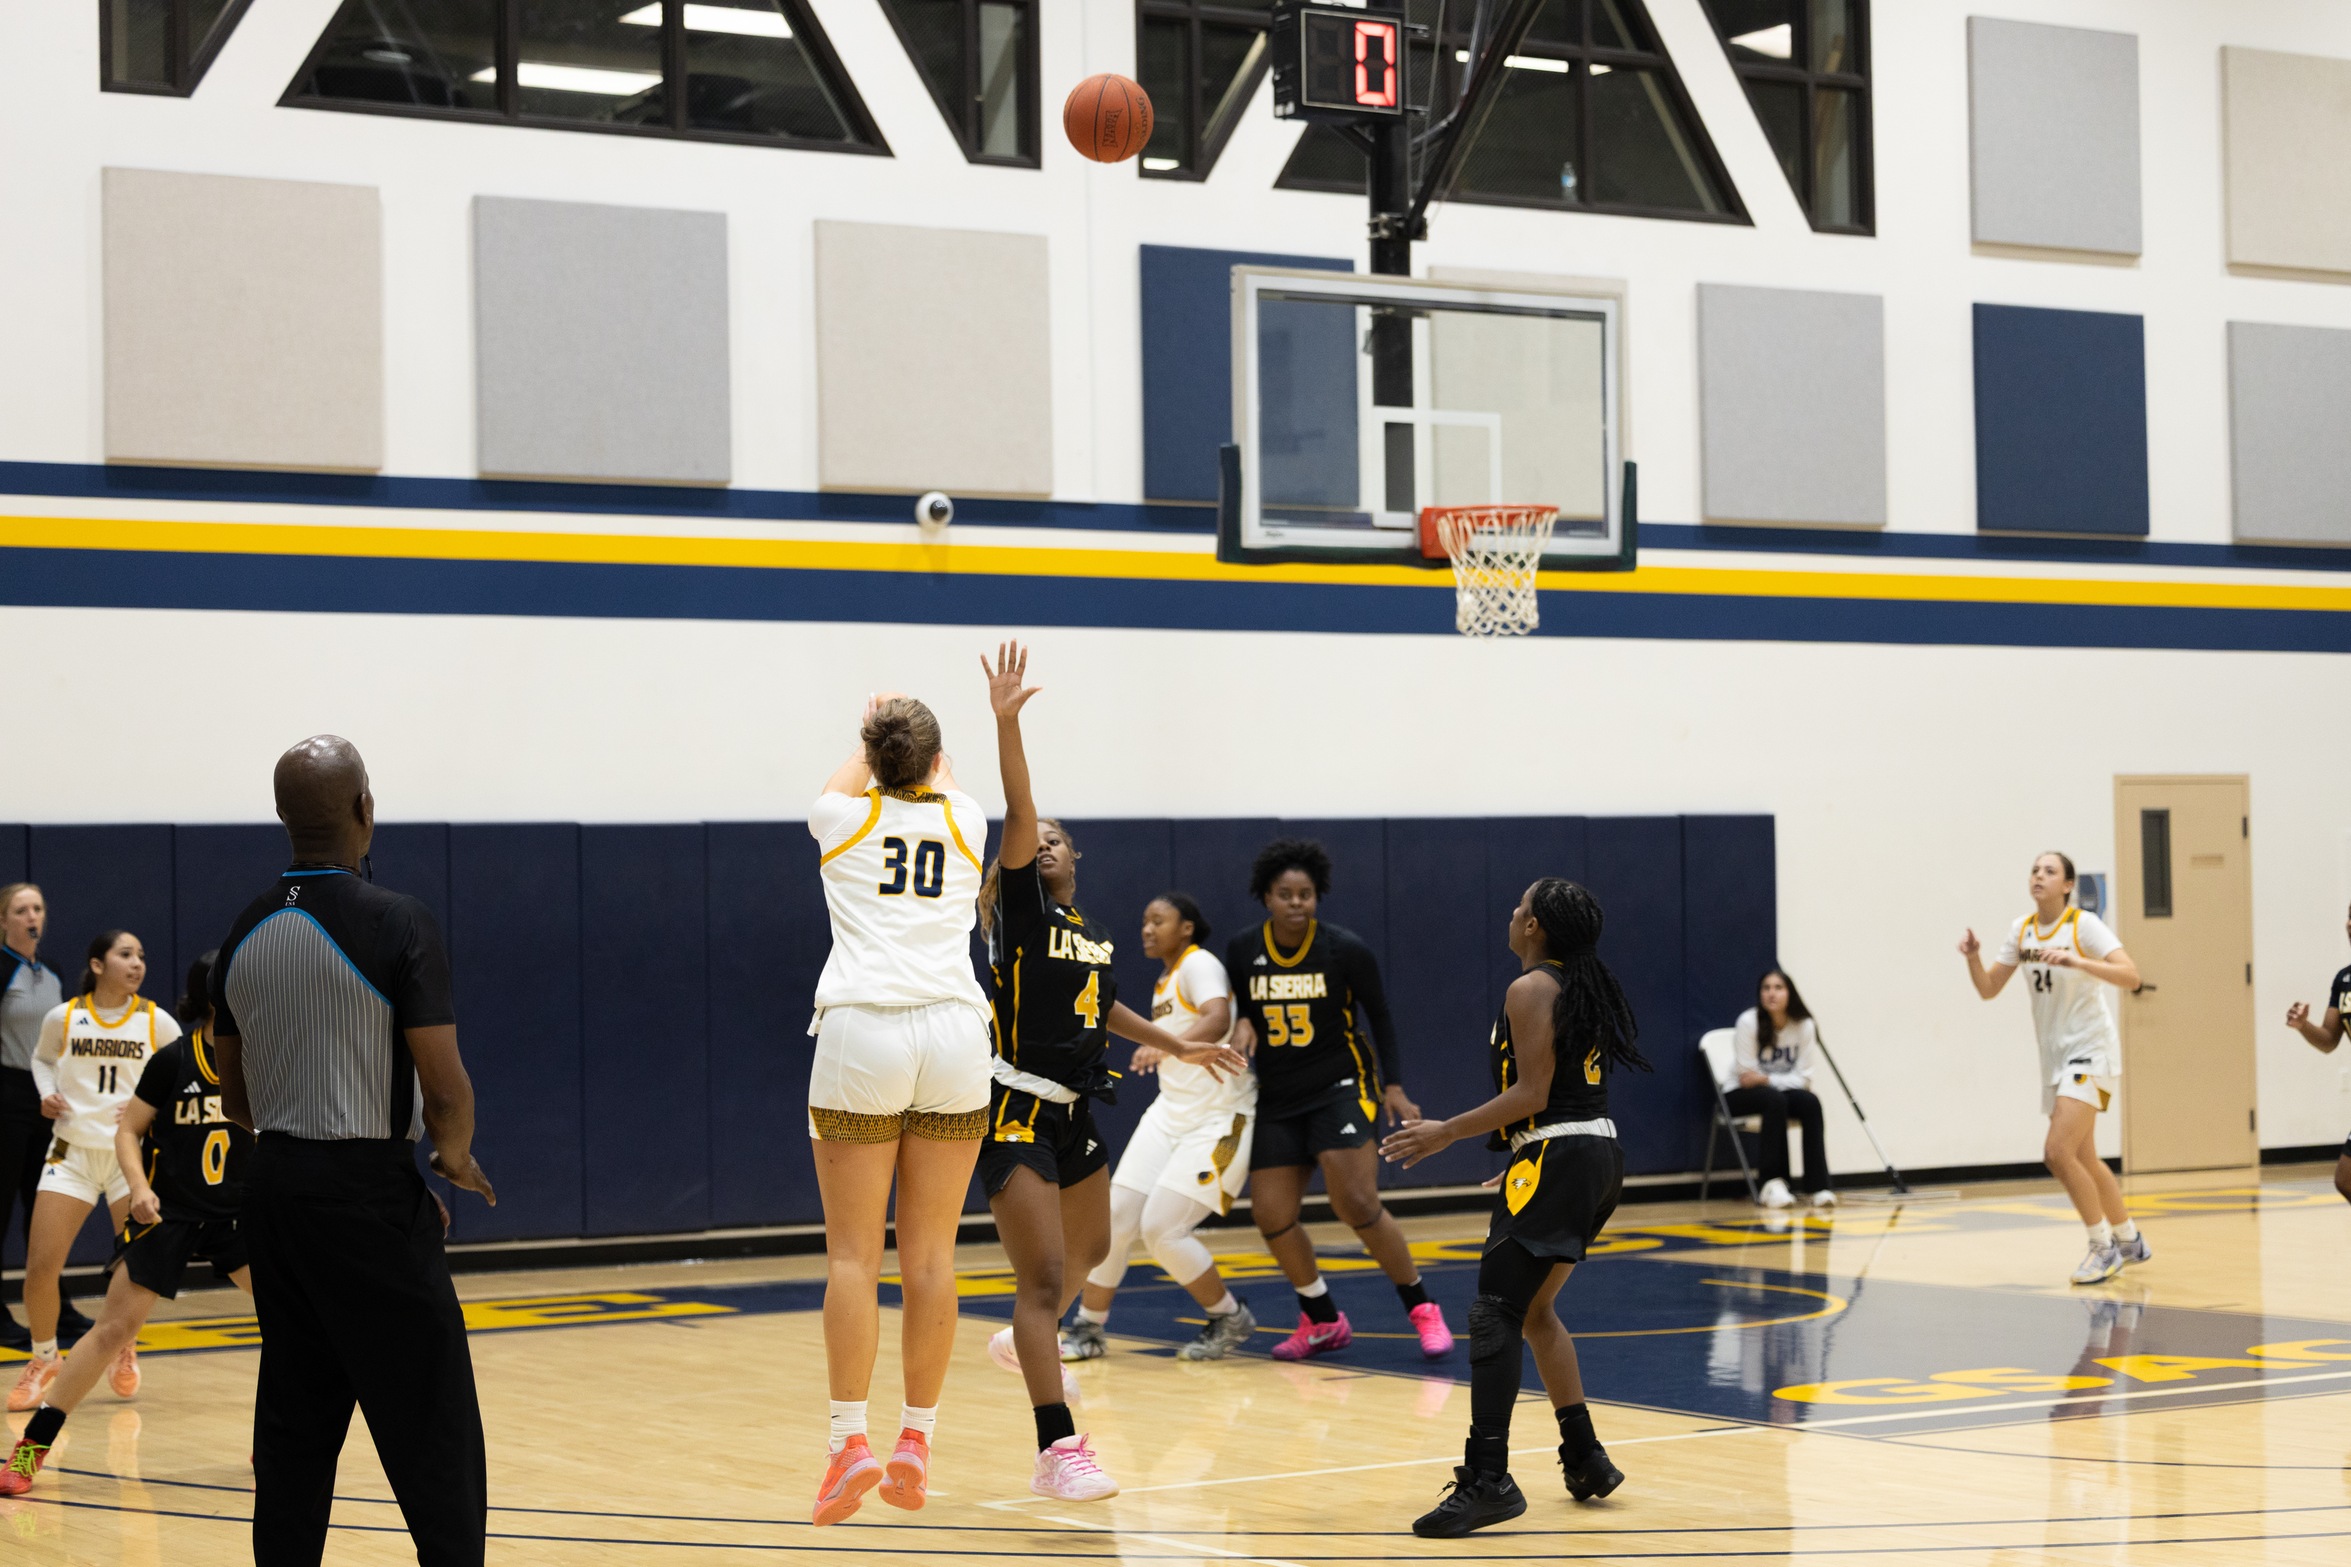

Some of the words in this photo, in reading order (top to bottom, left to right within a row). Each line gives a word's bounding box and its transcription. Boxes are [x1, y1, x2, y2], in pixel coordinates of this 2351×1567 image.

[1355, 21, 1396, 107] 0
[878, 836, 945, 898] 30
[1048, 926, 1075, 960] LA
[1249, 974, 1269, 1001] LA
[1269, 972, 1328, 1000] SIERRA
[2032, 969, 2053, 994] 24
[1074, 970, 1100, 1029] 4
[1262, 1003, 1315, 1047] 33
[71, 1038, 146, 1060] WARRIORS
[98, 1065, 117, 1094] 11
[175, 1097, 200, 1125] LA
[202, 1128, 231, 1186] 0
